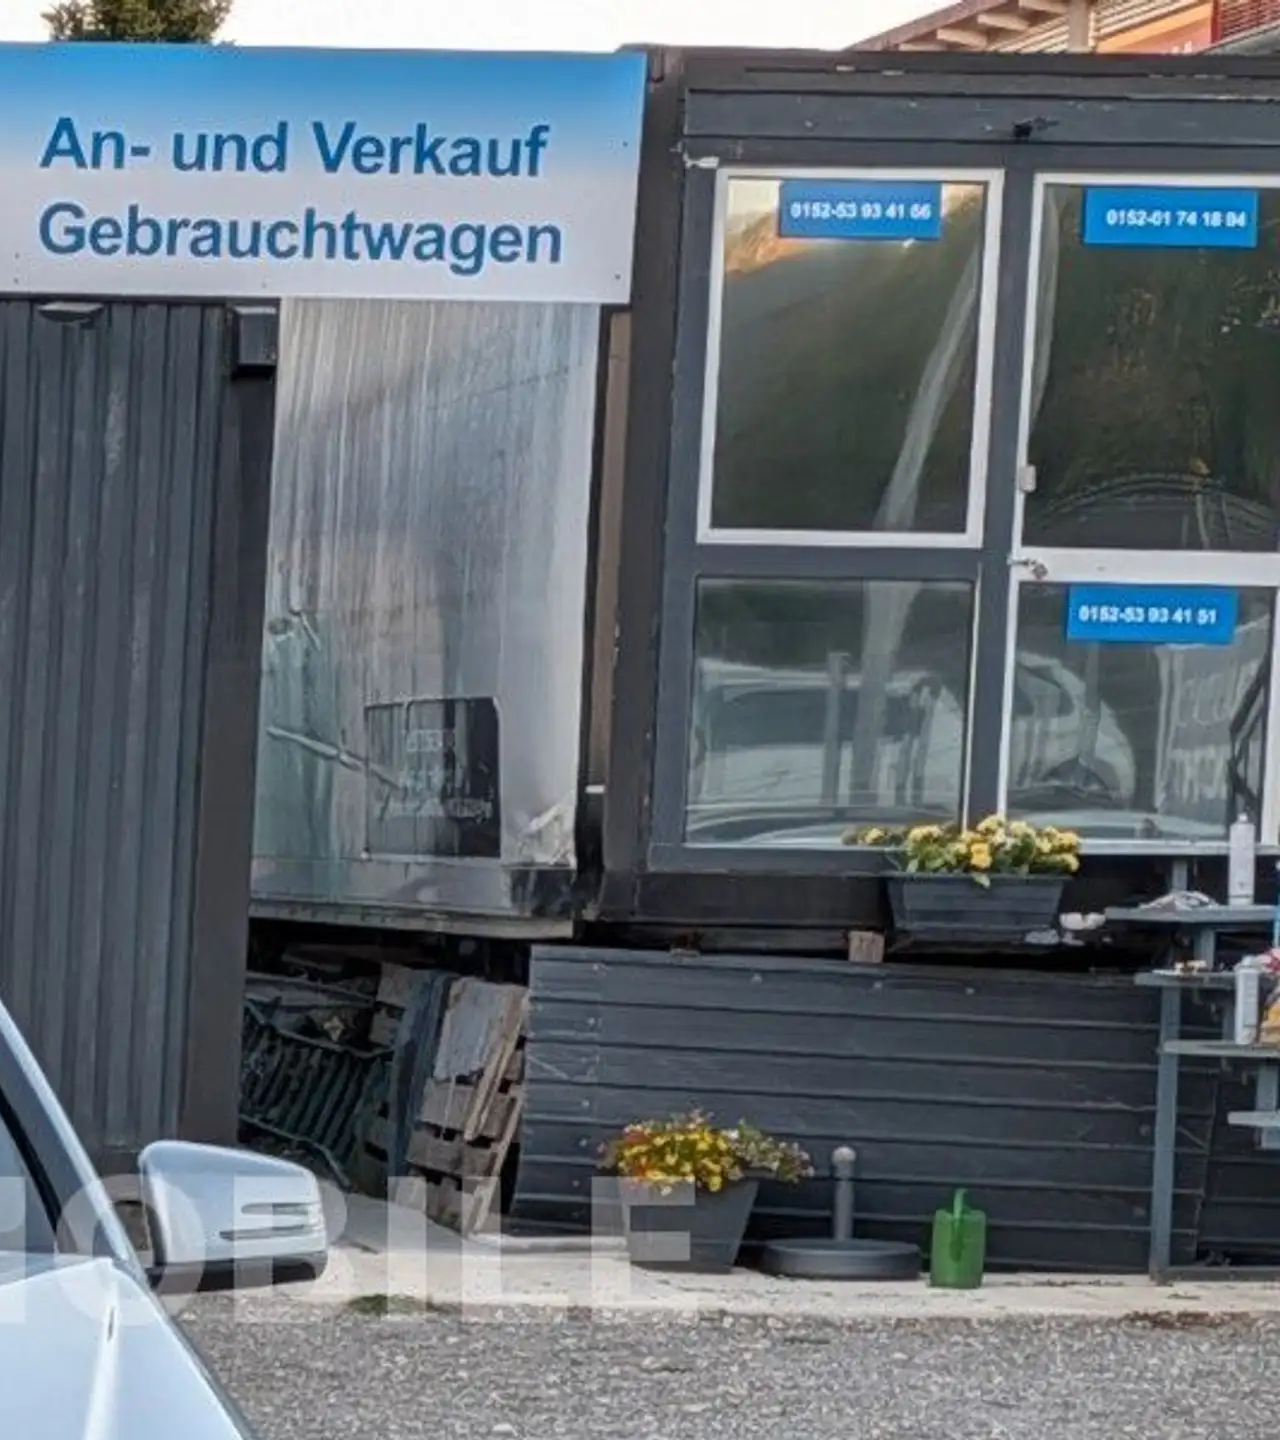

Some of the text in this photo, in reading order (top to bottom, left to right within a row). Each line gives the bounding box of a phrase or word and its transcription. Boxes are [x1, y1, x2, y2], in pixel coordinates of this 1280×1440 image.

[40, 117, 549, 178] An- und Verkauf
[40, 203, 562, 277] Gebrauchtwagen
[1175, 210, 1198, 226] 74
